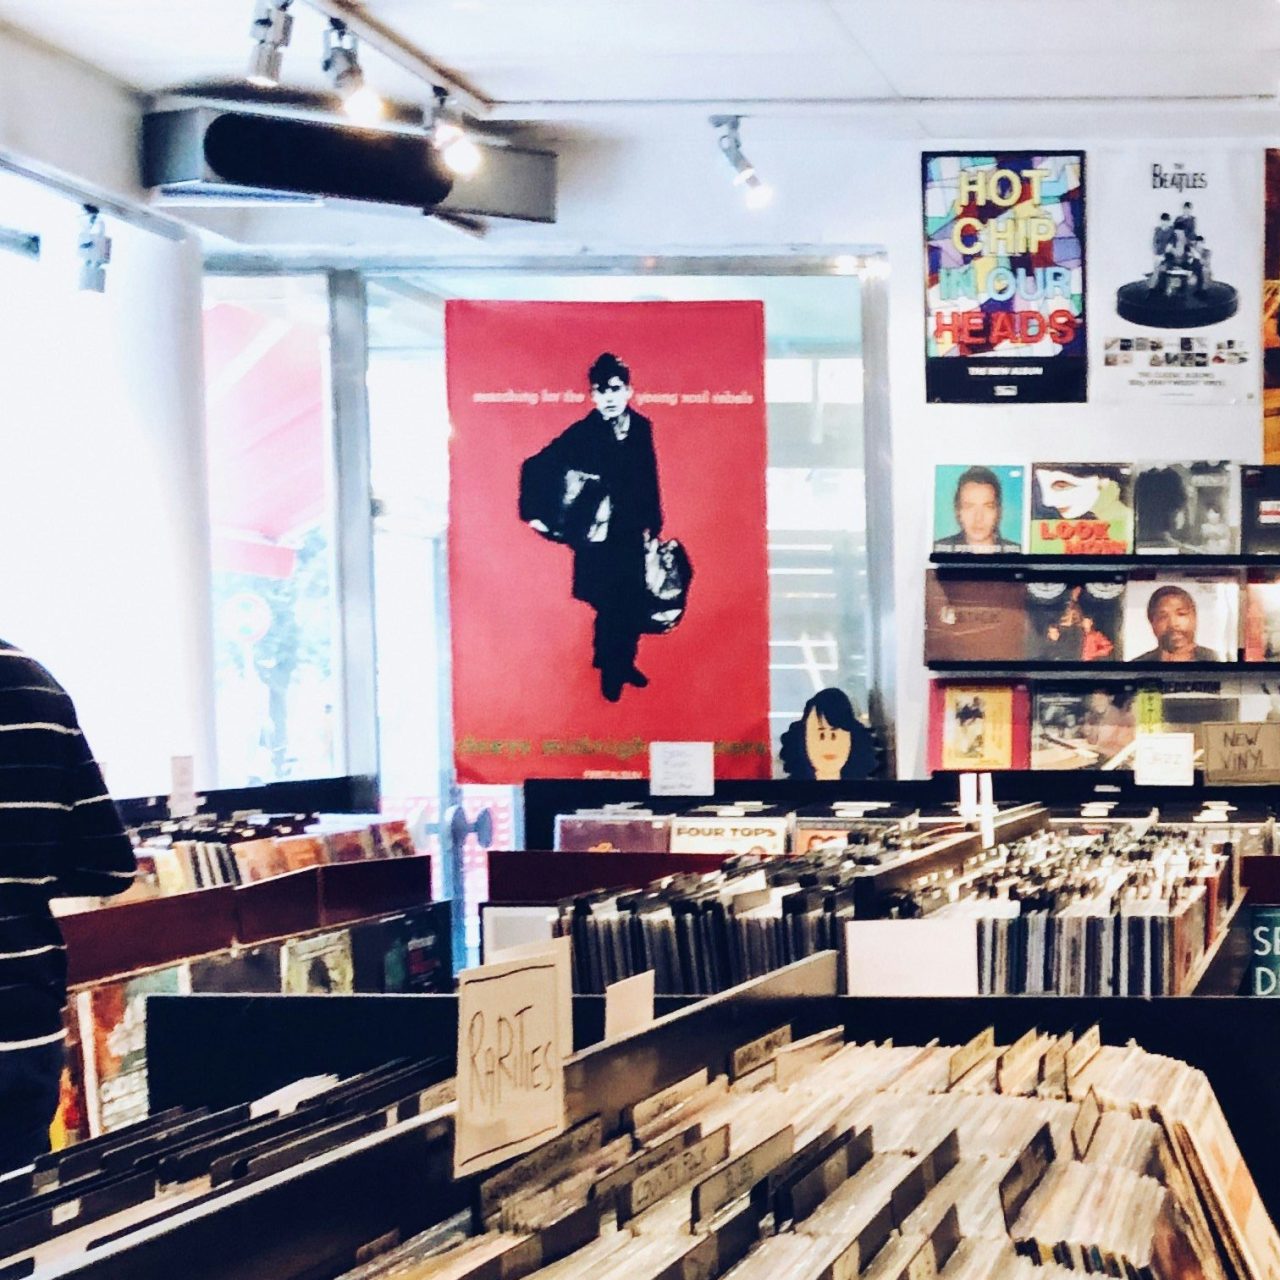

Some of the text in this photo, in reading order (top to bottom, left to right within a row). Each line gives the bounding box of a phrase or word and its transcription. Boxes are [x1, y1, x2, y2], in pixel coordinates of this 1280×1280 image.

[959, 168, 1050, 207] HOT
[1152, 163, 1208, 192] BEATLES
[952, 215, 1057, 256] CHIP
[939, 266, 1073, 302] IN OUR
[933, 309, 1077, 346] HEADS
[1224, 730, 1261, 747] NEW
[1221, 750, 1269, 771] VINYL
[676, 827, 777, 839] FOUR TOPS
